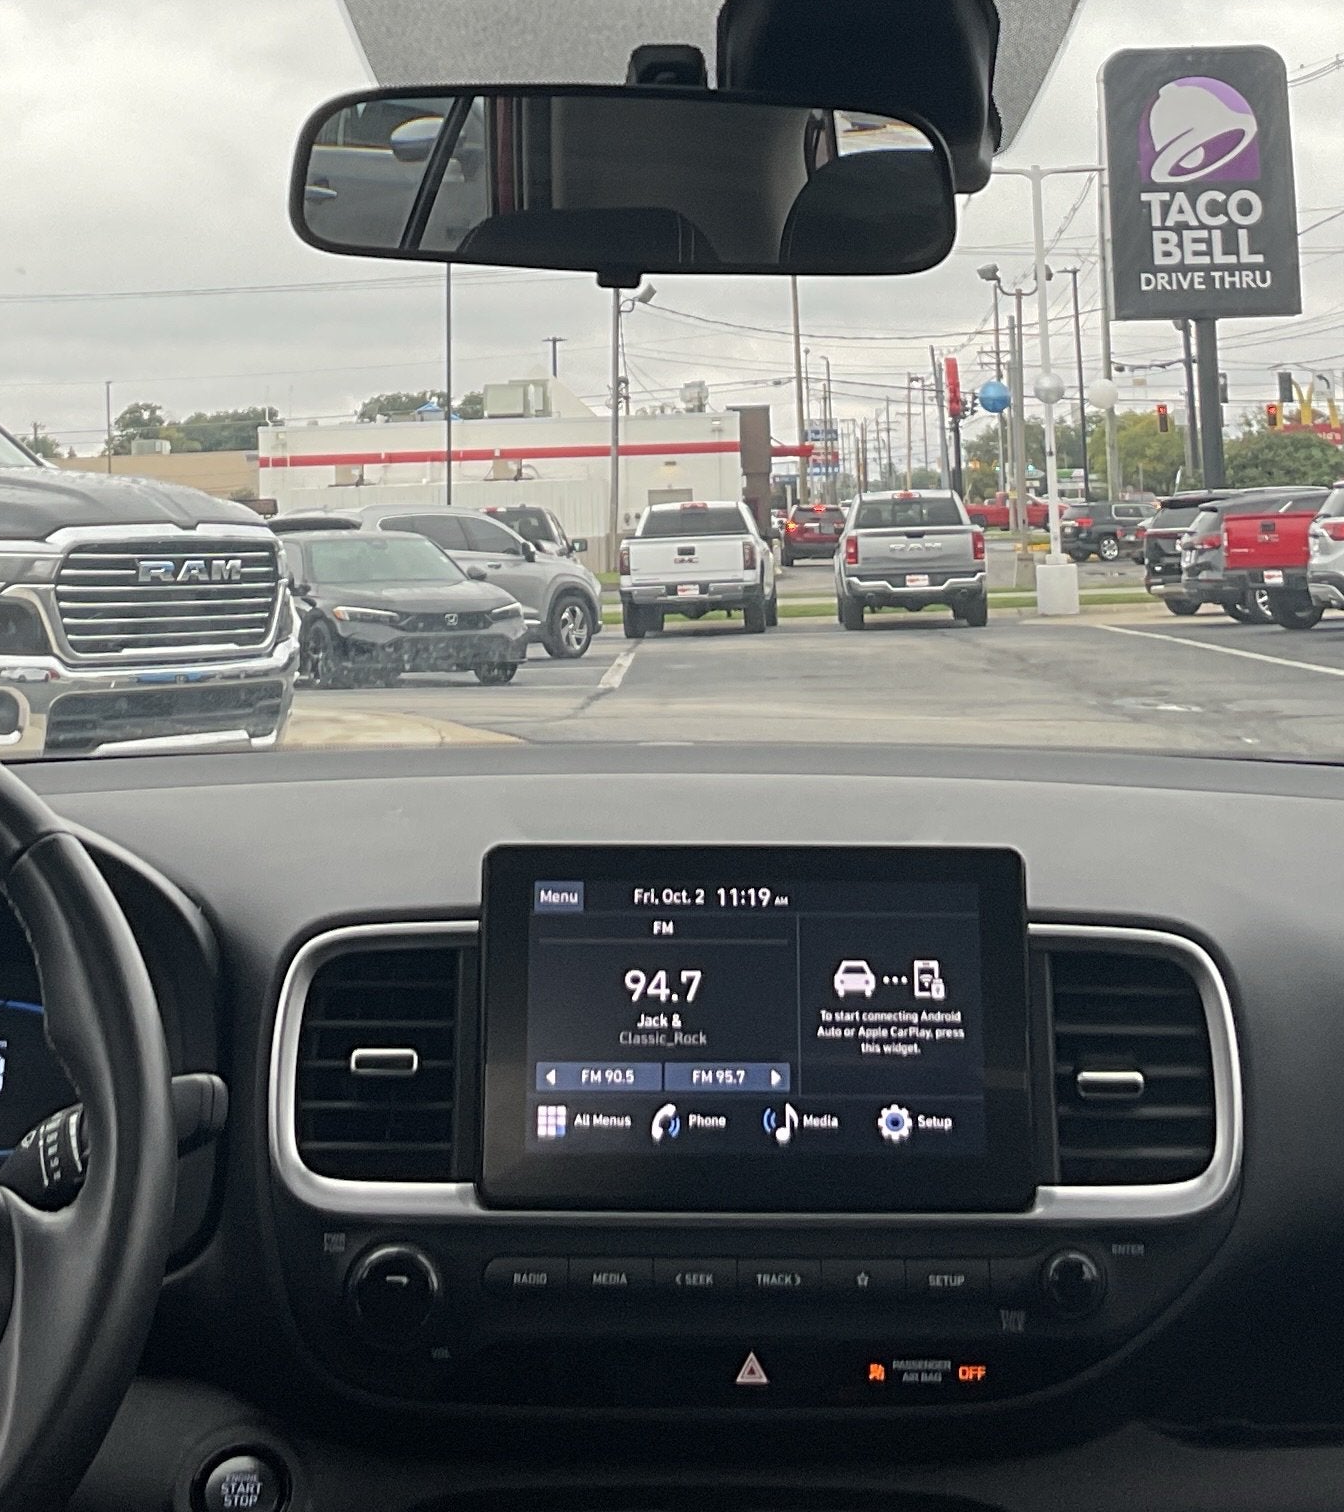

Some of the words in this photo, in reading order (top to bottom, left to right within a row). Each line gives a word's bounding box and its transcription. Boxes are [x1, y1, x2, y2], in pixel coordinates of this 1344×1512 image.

[1140, 189, 1263, 227] TACO
[1152, 228, 1265, 265] BELL
[1140, 272, 1207, 291] DRIVE
[1210, 270, 1272, 289] THRU
[888, 542, 943, 553] RAM
[138, 559, 242, 582] RAM
[540, 889, 578, 903] Menu
[662, 888, 691, 904] Oct.
[695, 888, 705, 905] 2
[717, 888, 771, 907] 11:19
[774, 896, 789, 906] AM
[653, 920, 674, 935] FM
[624, 969, 702, 1003] 94.7
[637, 1012, 668, 1028] Jack
[672, 1013, 682, 1028] &
[820, 1009, 833, 1021] To
[834, 1010, 860, 1022] start
[861, 1010, 919, 1023] connecting
[920, 1010, 962, 1023] Android
[619, 1031, 707, 1046] Classic_Rock
[817, 1026, 842, 1038] Auto
[843, 1028, 855, 1038] or
[858, 1026, 889, 1039] Apple
[935, 1028, 965, 1040] press
[861, 1042, 881, 1053] this
[581, 1070, 602, 1084] FM
[605, 1070, 635, 1084] 90.5
[692, 1070, 713, 1084] FM
[715, 1070, 746, 1084] 95.7
[574, 1114, 590, 1128] All
[592, 1114, 632, 1128] Menus
[689, 1113, 727, 1128] Phone
[803, 1113, 839, 1128] Media
[917, 1114, 953, 1131] Setup
[513, 1272, 548, 1285] RADIO
[593, 1272, 628, 1285] MEDIA
[685, 1273, 715, 1286] SEEK
[756, 1273, 791, 1286] TRACK
[928, 1274, 965, 1287] SETUP
[959, 1365, 986, 1381] OFF
[220, 1482, 263, 1495] START
[223, 1495, 258, 1508] STOP
